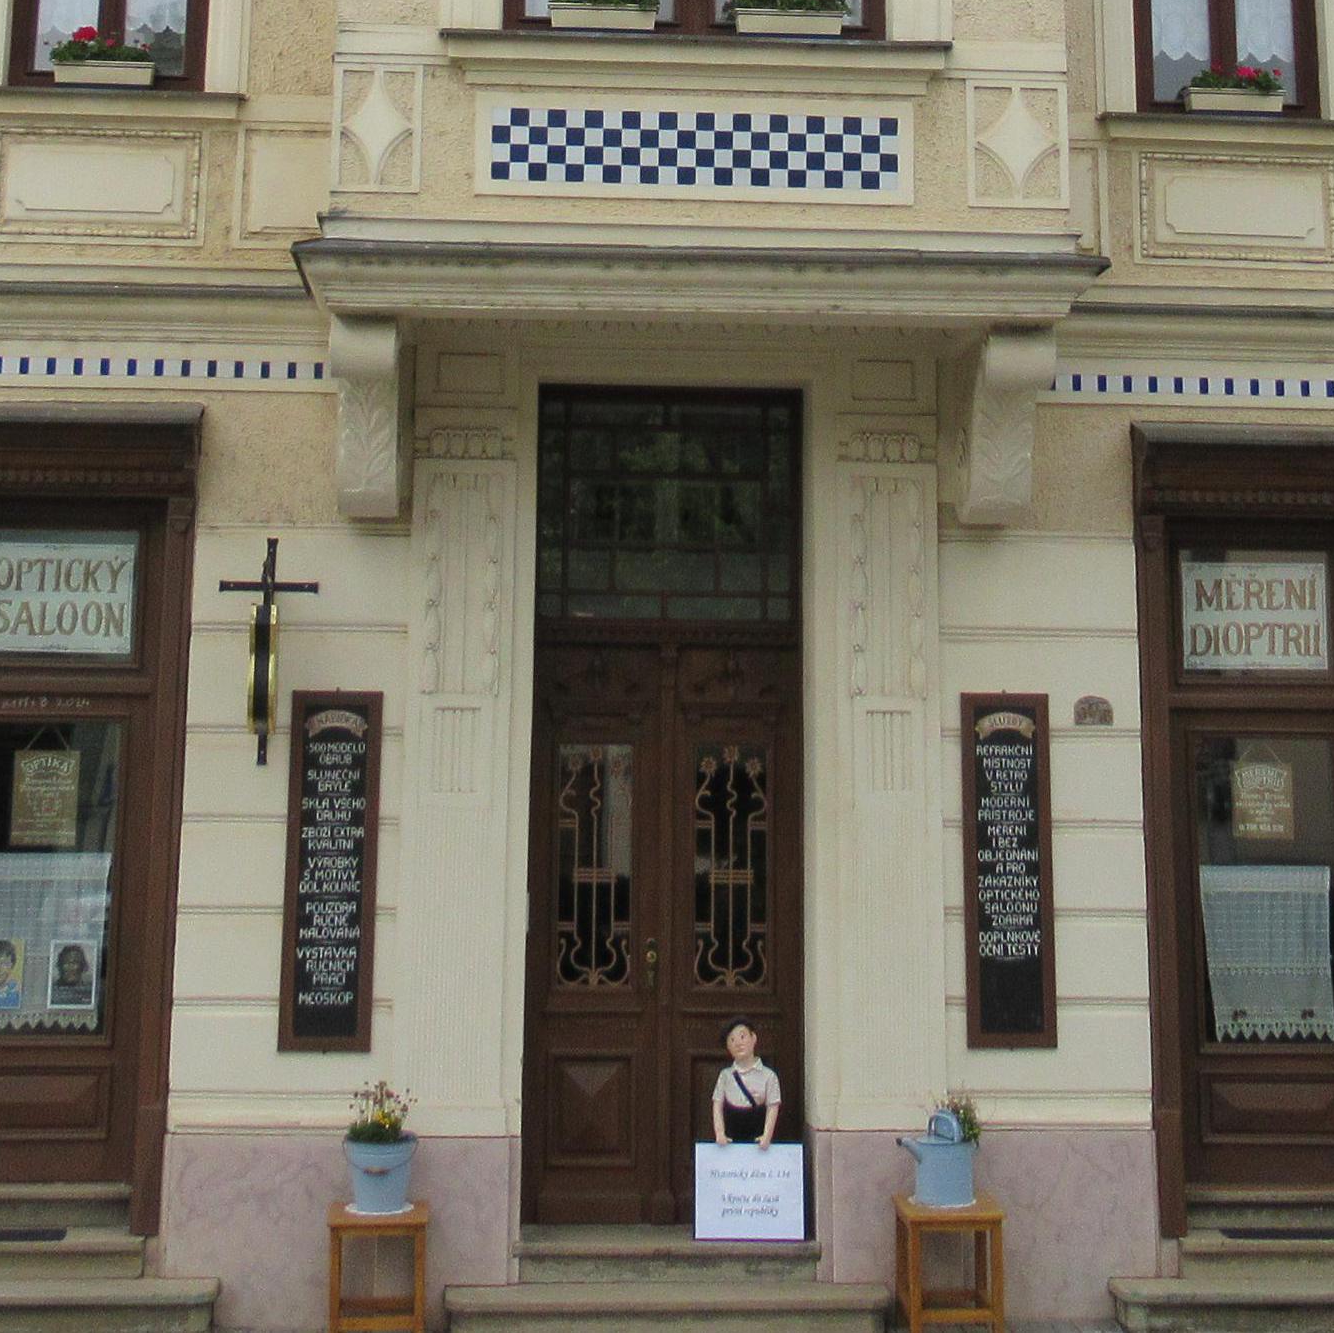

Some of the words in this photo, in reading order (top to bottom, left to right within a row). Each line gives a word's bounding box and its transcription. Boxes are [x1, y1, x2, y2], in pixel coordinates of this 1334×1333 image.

[1195, 573, 1317, 612] MĚŘENÍ
[1190, 619, 1323, 657] DIOPTRIÍ
[986, 770, 994, 781] V
[996, 769, 1027, 781] RETRO
[990, 781, 1023, 793] STYLU
[302, 797, 329, 809] SKLA
[316, 810, 352, 822] DRUHU
[998, 837, 1018, 848] BEZ
[996, 862, 1004, 874] A
[1006, 862, 1026, 874] PRO
[304, 869, 310, 881] S
[991, 914, 1033, 926] ZDARMA
[1007, 943, 1039, 956] TESTY
